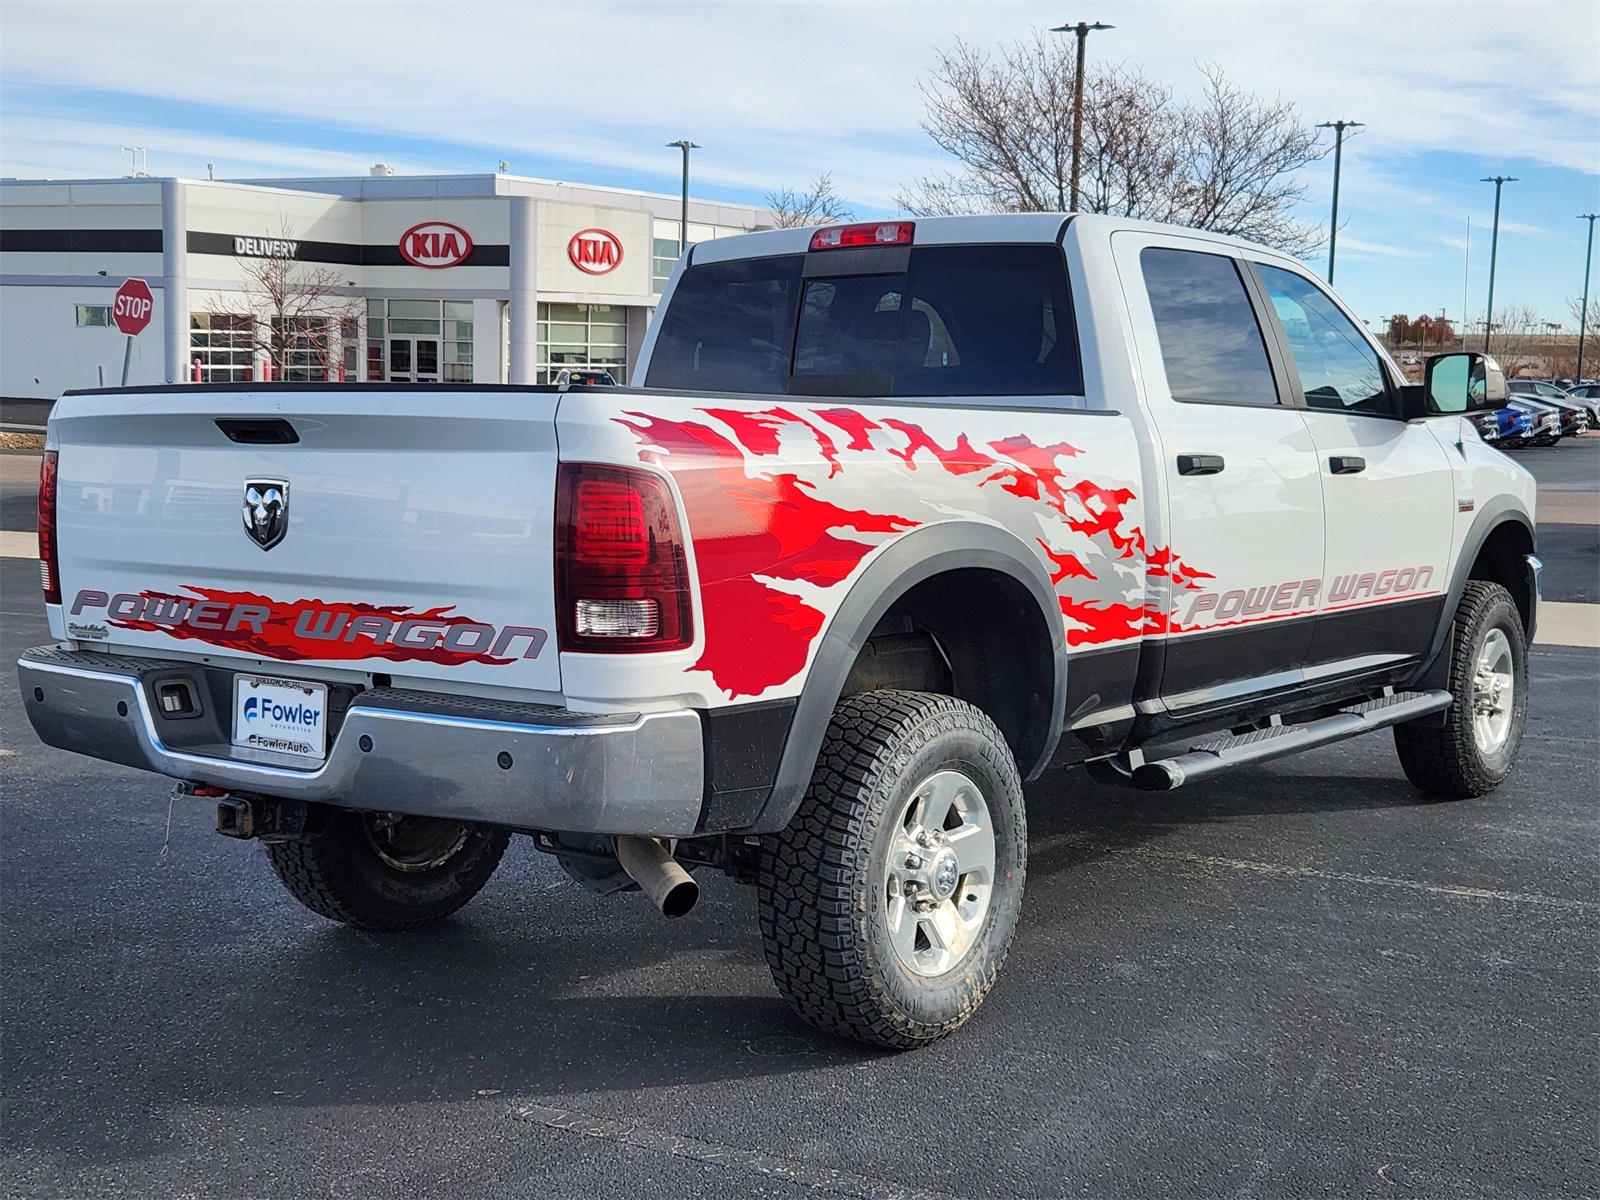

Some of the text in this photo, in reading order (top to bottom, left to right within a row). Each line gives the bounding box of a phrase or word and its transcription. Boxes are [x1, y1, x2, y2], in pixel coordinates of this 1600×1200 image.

[234, 237, 297, 258] DELIVERY
[412, 233, 461, 258] KIA
[577, 238, 616, 266] KIA
[115, 295, 151, 319] STOP
[1182, 565, 1434, 625] POWER WAGON
[69, 589, 549, 660] POWER WAGON
[261, 698, 320, 726] Fowler
[270, 723, 311, 733] AUTOMOTIVE
[257, 737, 309, 753] FowlerAuto
